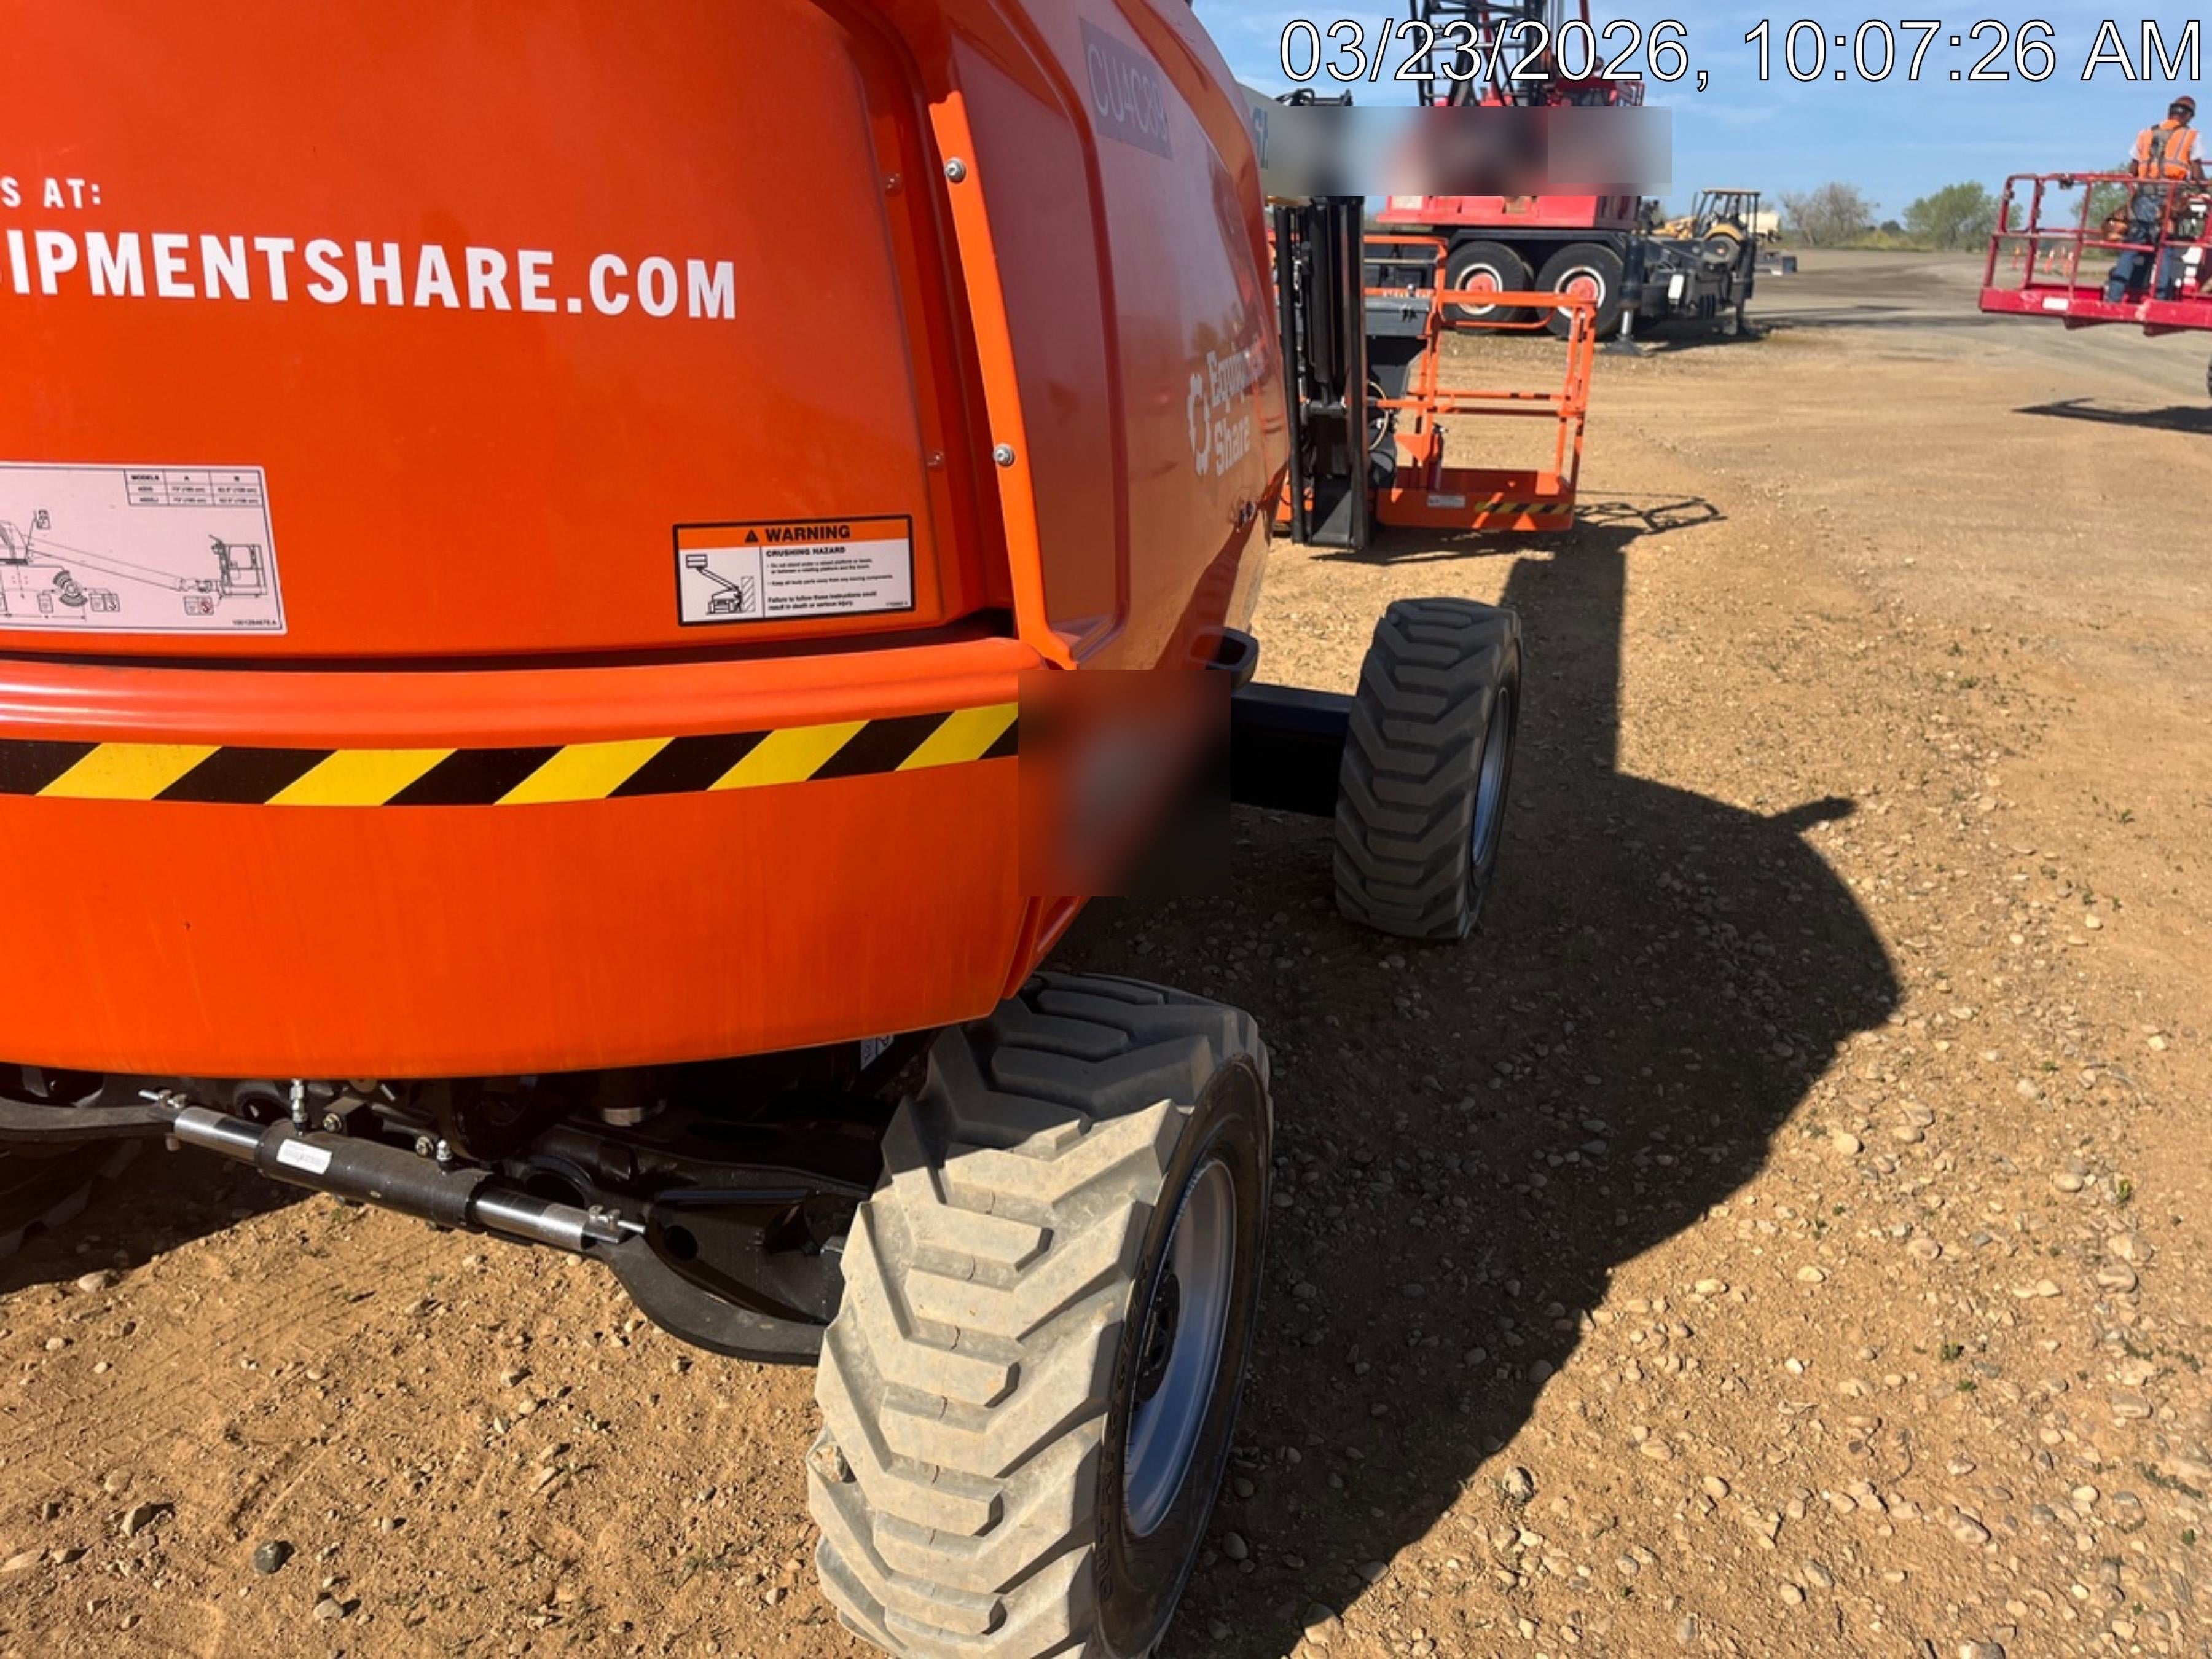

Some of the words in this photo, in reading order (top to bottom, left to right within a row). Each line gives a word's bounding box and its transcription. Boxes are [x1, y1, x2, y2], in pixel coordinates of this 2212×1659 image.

[44, 178, 101, 209] AT:
[0, 229, 736, 320] IPMENTSHARE.COM
[1214, 415, 1250, 476] Share
[765, 525, 850, 543] WARNING
